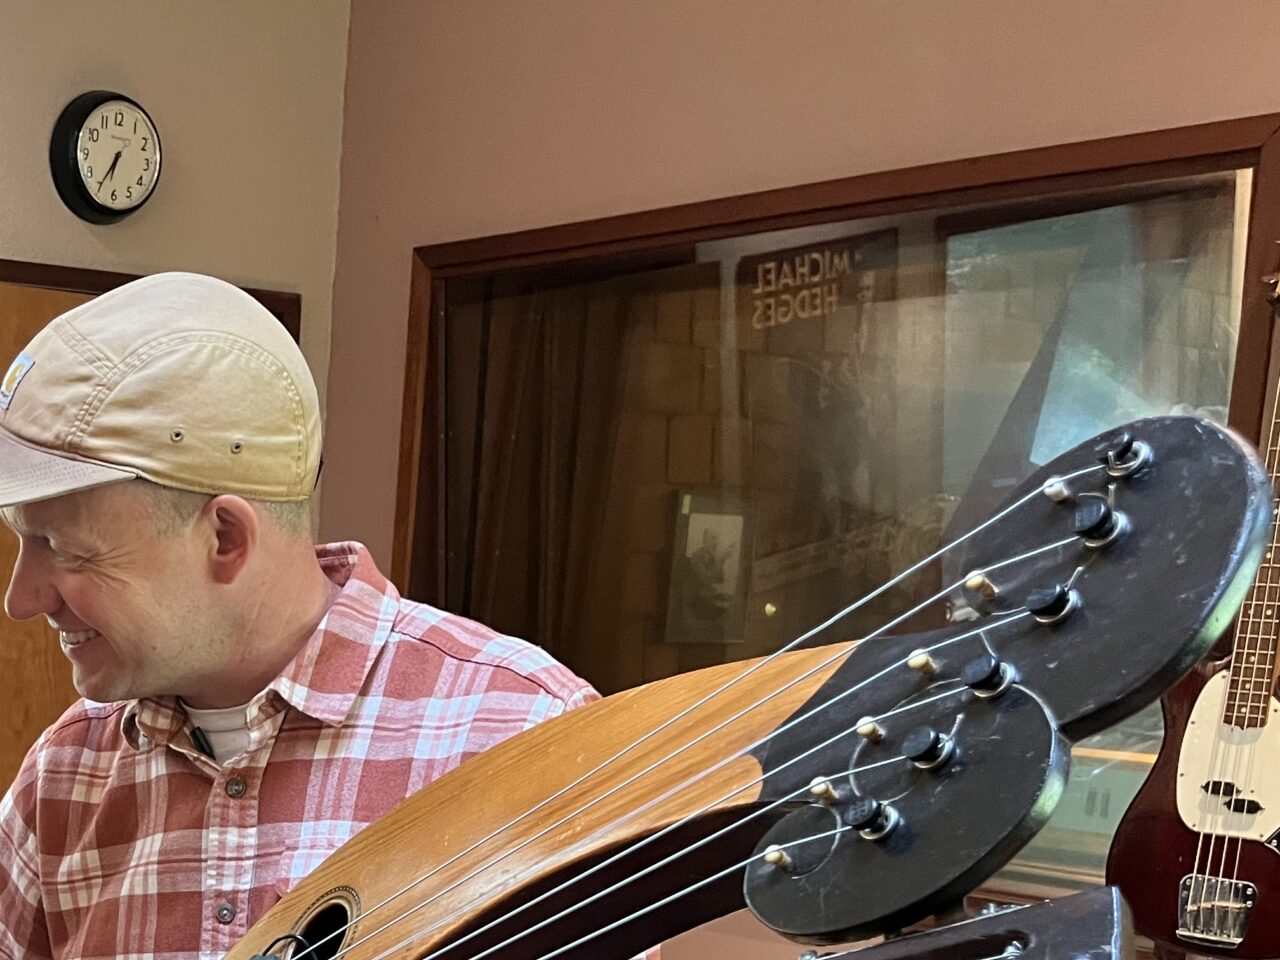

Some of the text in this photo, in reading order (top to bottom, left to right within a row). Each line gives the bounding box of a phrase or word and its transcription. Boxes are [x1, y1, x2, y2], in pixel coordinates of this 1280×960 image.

[101, 114, 108, 130] 11
[114, 112, 124, 127] 12
[133, 120, 138, 135] 1
[88, 128, 99, 142] 10
[141, 137, 148, 151] 2
[82, 148, 89, 161] 9
[86, 165, 93, 178] 8
[143, 158, 150, 171] 3
[136, 174, 143, 187] 4
[110, 188, 117, 202] 6
[125, 186, 132, 199] 5
